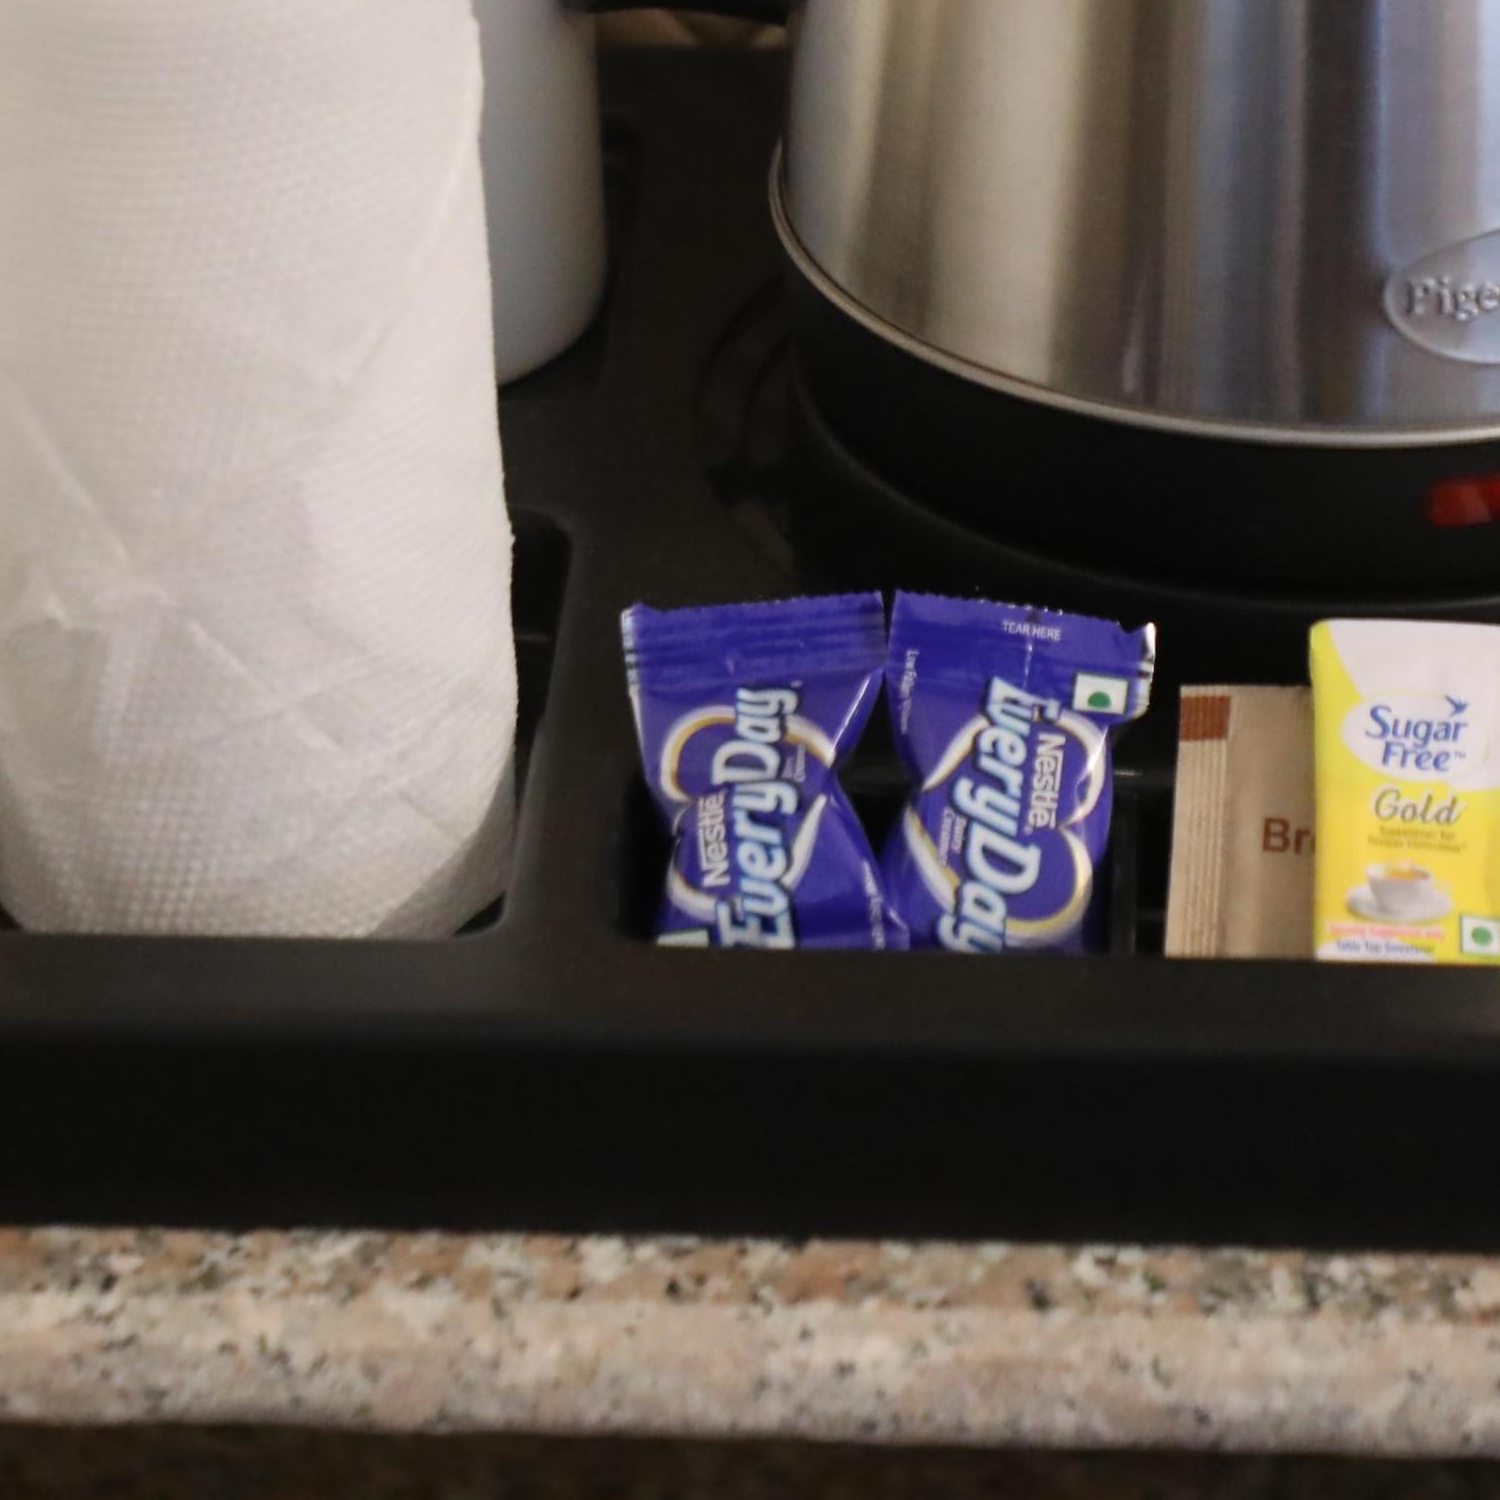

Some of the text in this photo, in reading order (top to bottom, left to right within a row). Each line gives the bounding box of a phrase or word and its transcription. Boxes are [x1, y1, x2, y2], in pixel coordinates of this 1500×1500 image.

[1002, 620, 1062, 642] TEAR HERE
[1364, 704, 1469, 749] Sugar
[1381, 741, 1451, 773] Free
[1374, 788, 1462, 826] Gold
[1262, 817, 1316, 855] Br
